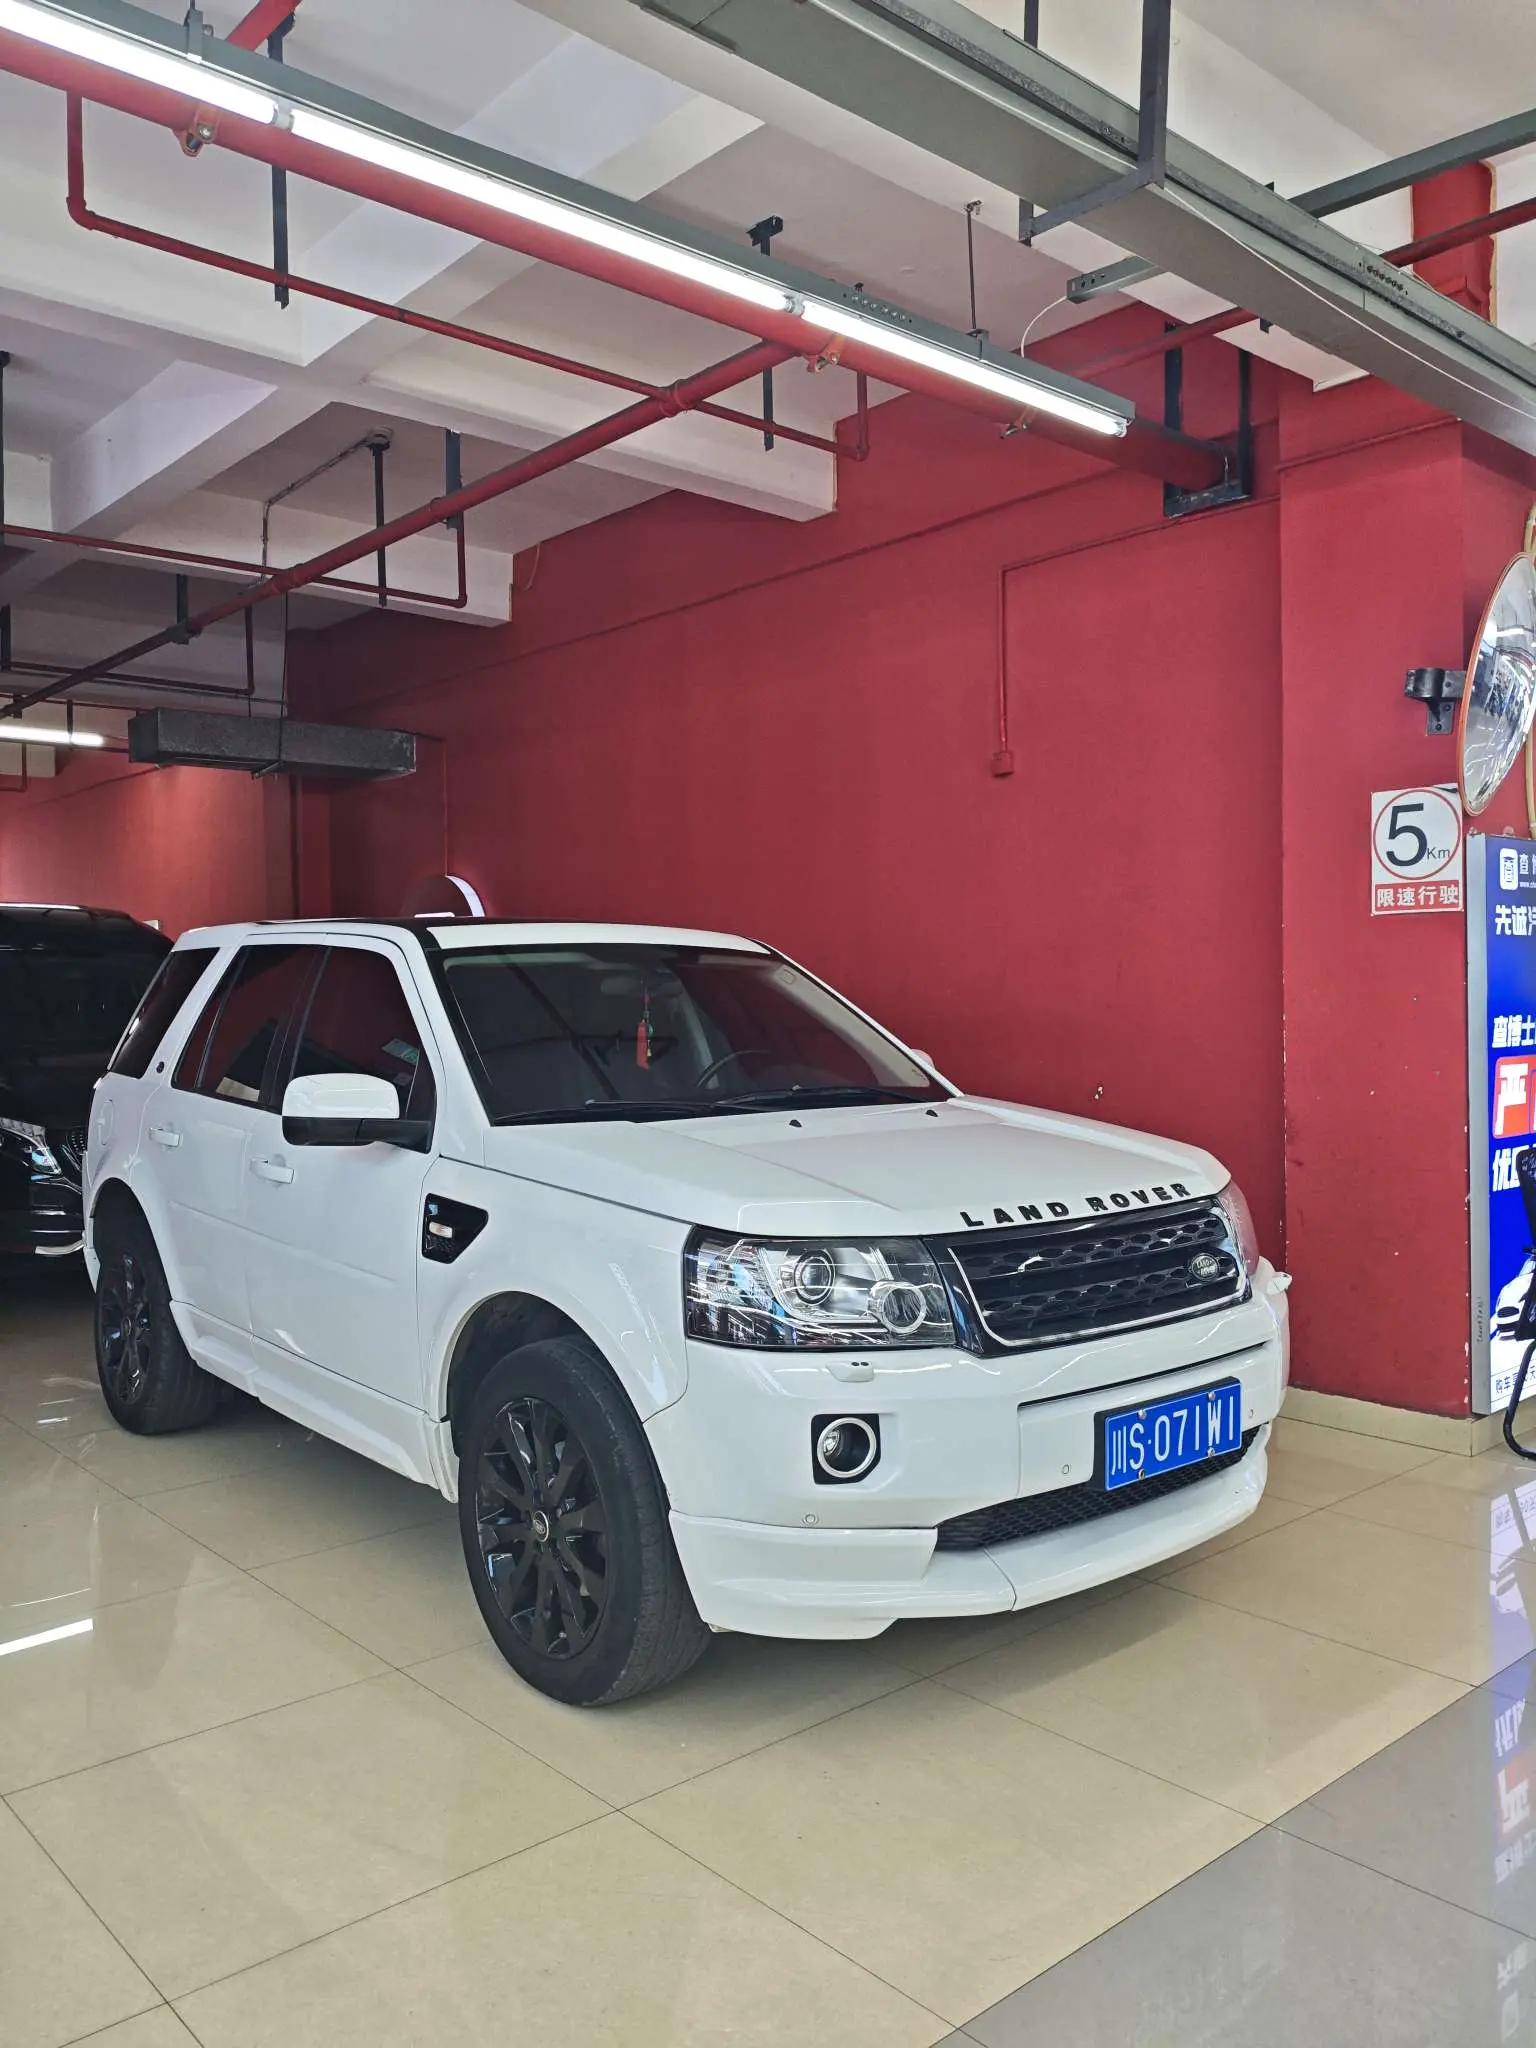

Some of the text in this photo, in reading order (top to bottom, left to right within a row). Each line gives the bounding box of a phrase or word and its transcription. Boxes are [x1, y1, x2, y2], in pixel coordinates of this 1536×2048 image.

[1386, 803, 1451, 867] 5 Km
[1376, 884, 1459, 908] 限速行驶
[1492, 1014, 1536, 1048] 查博士
[960, 1183, 1191, 1228] LAND ROVER
